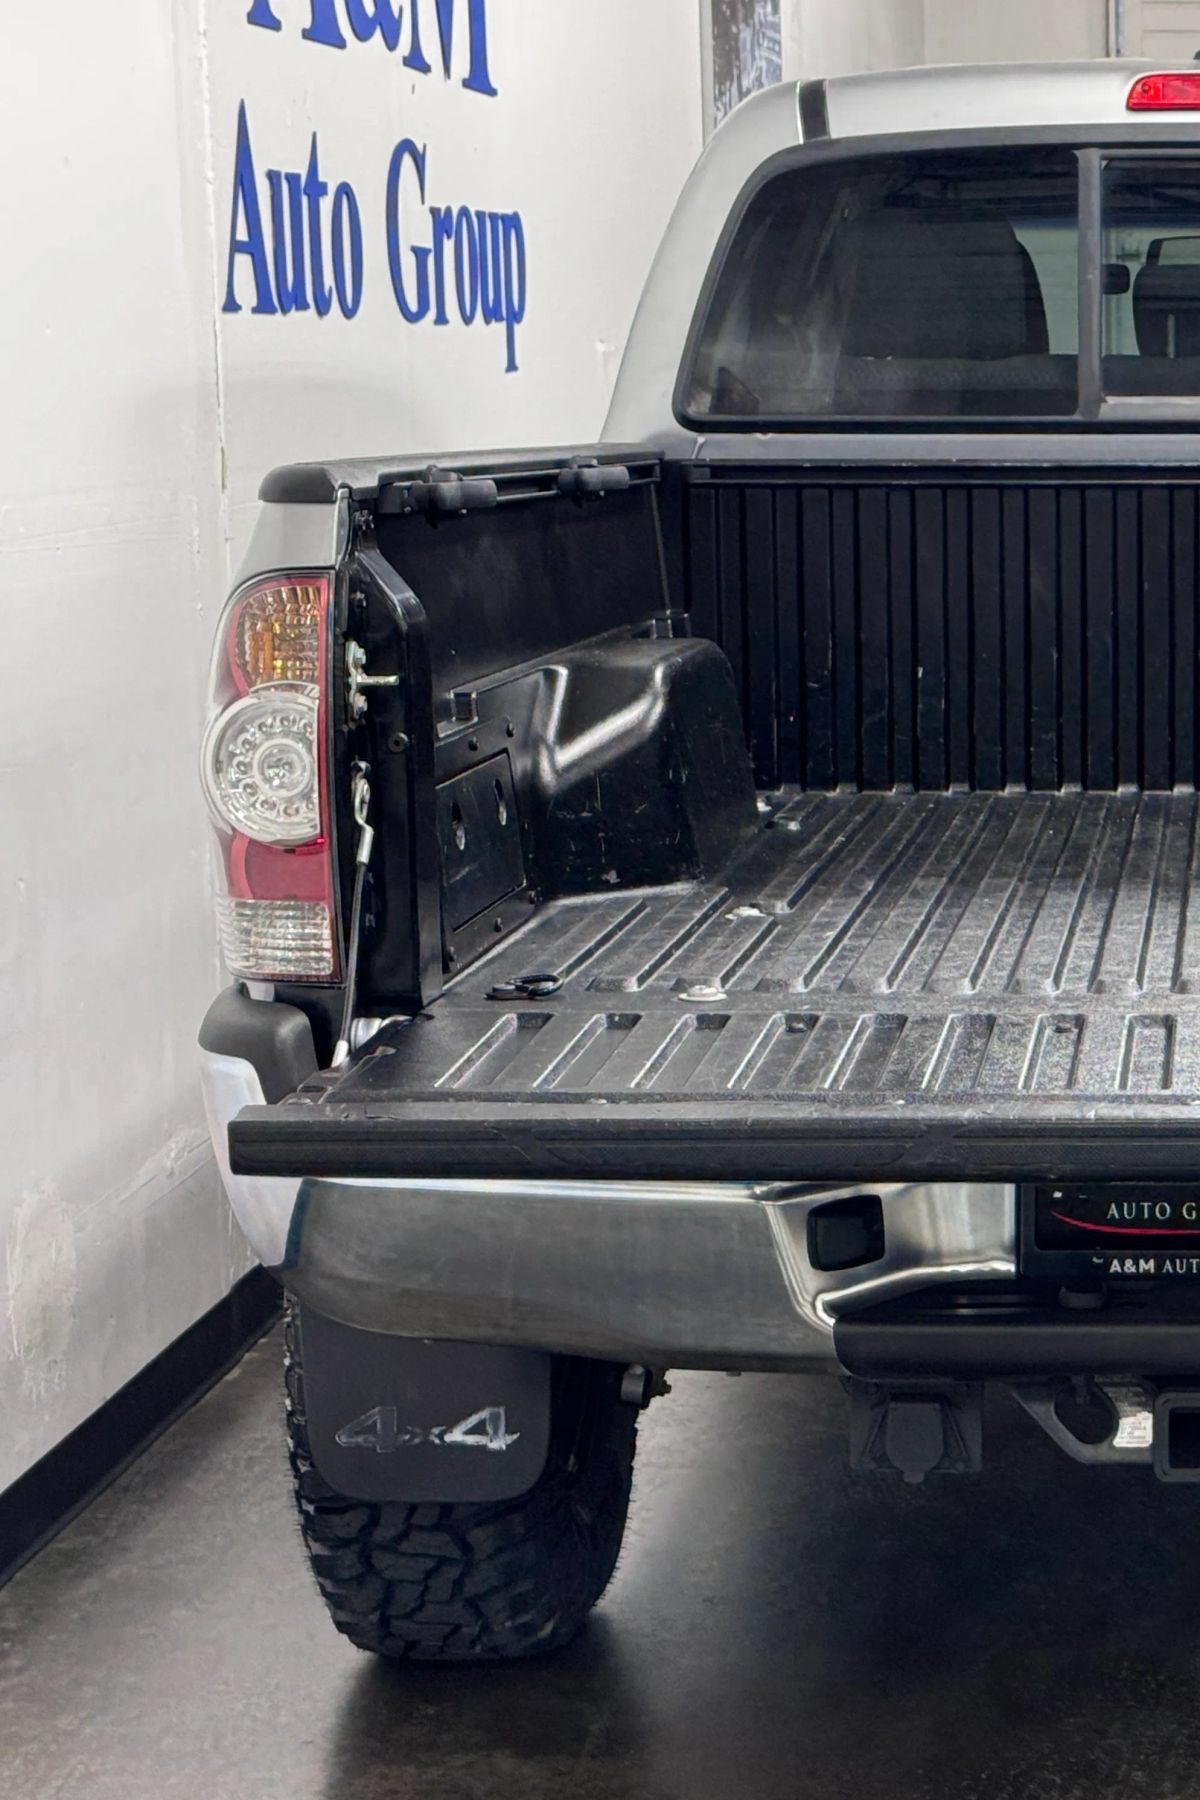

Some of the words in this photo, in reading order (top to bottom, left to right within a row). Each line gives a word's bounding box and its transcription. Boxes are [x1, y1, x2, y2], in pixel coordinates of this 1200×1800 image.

[222, 98, 363, 319] Auto
[386, 138, 527, 373] Group
[1106, 1201, 1172, 1220] AUTO
[1108, 1257, 1156, 1274] A&M
[335, 1406, 521, 1452] 4x4
